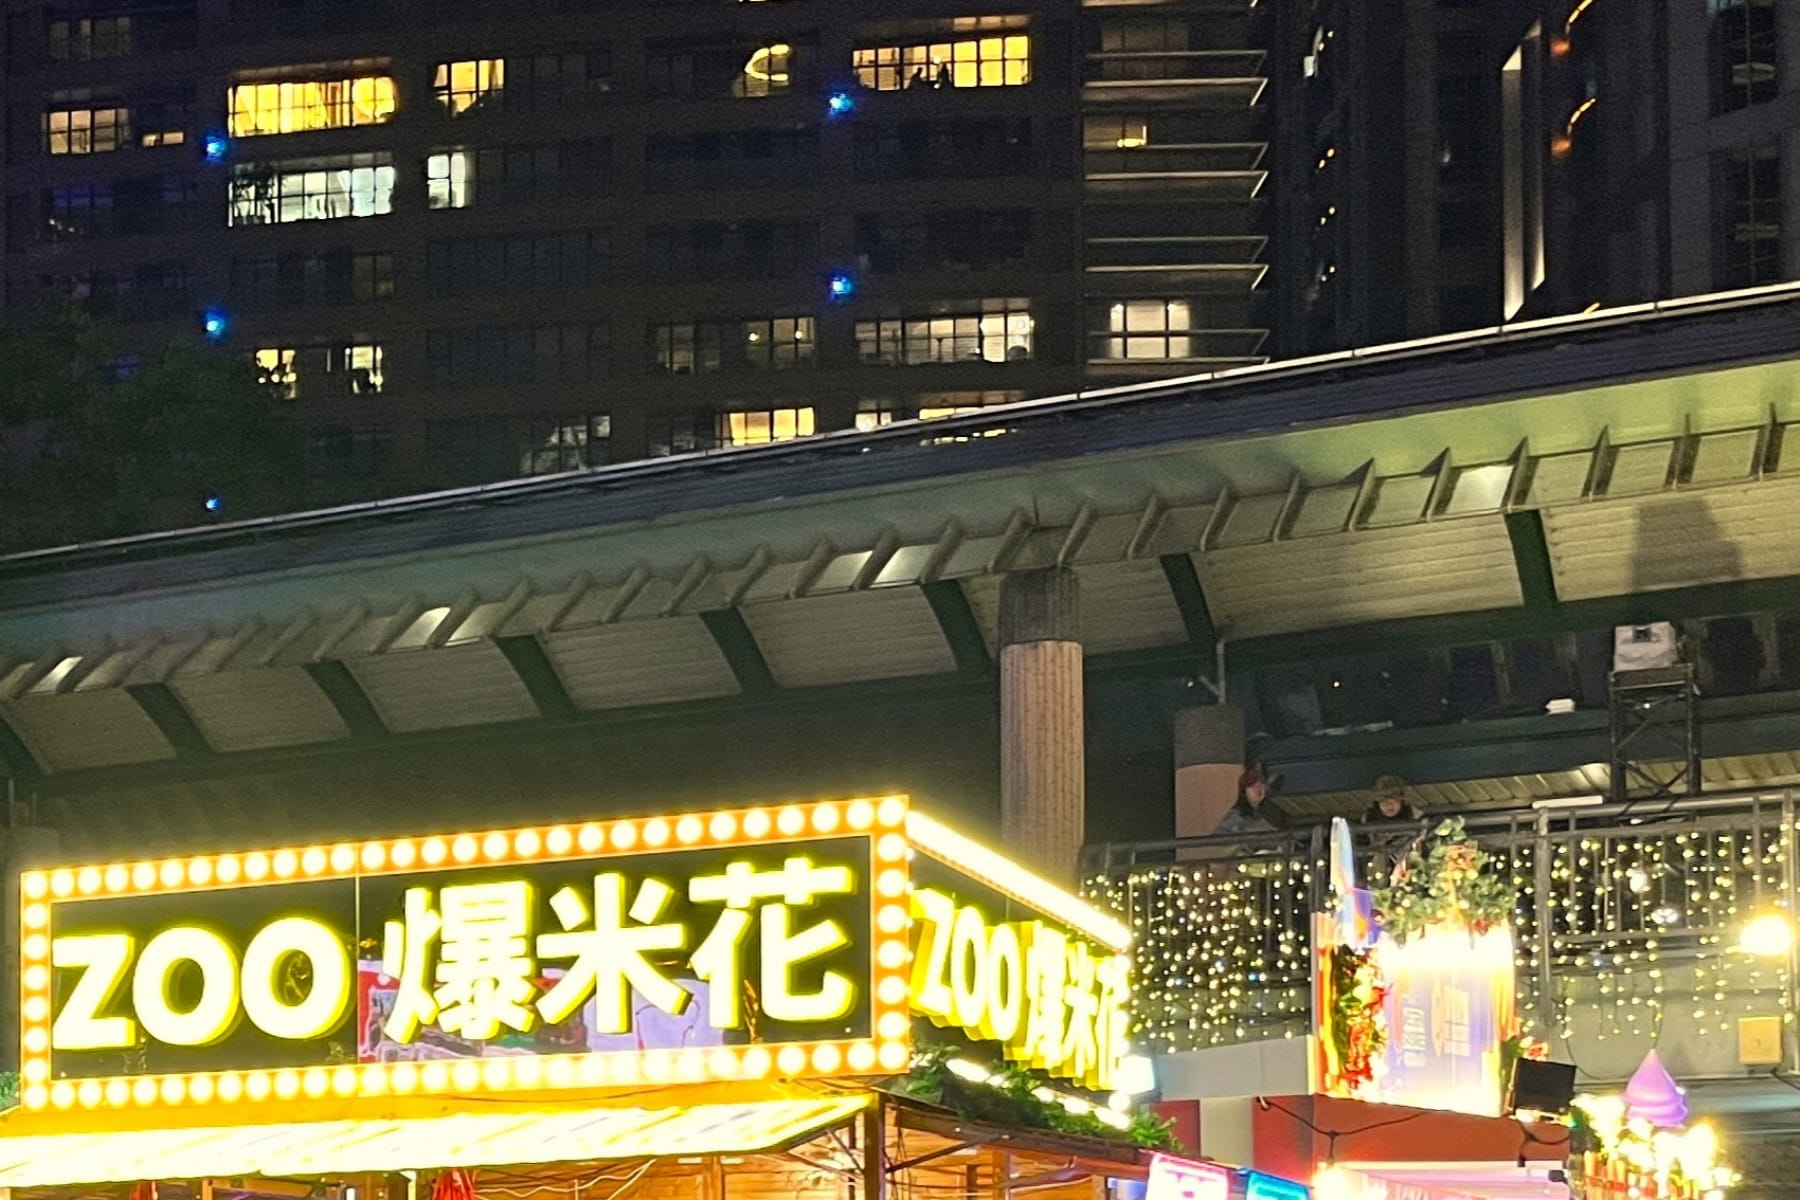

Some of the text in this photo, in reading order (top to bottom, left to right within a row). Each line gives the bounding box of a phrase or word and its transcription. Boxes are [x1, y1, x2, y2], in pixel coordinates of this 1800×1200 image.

[49, 857, 855, 1053] ZOO 爆米花
[908, 887, 1023, 1043] ZOO
